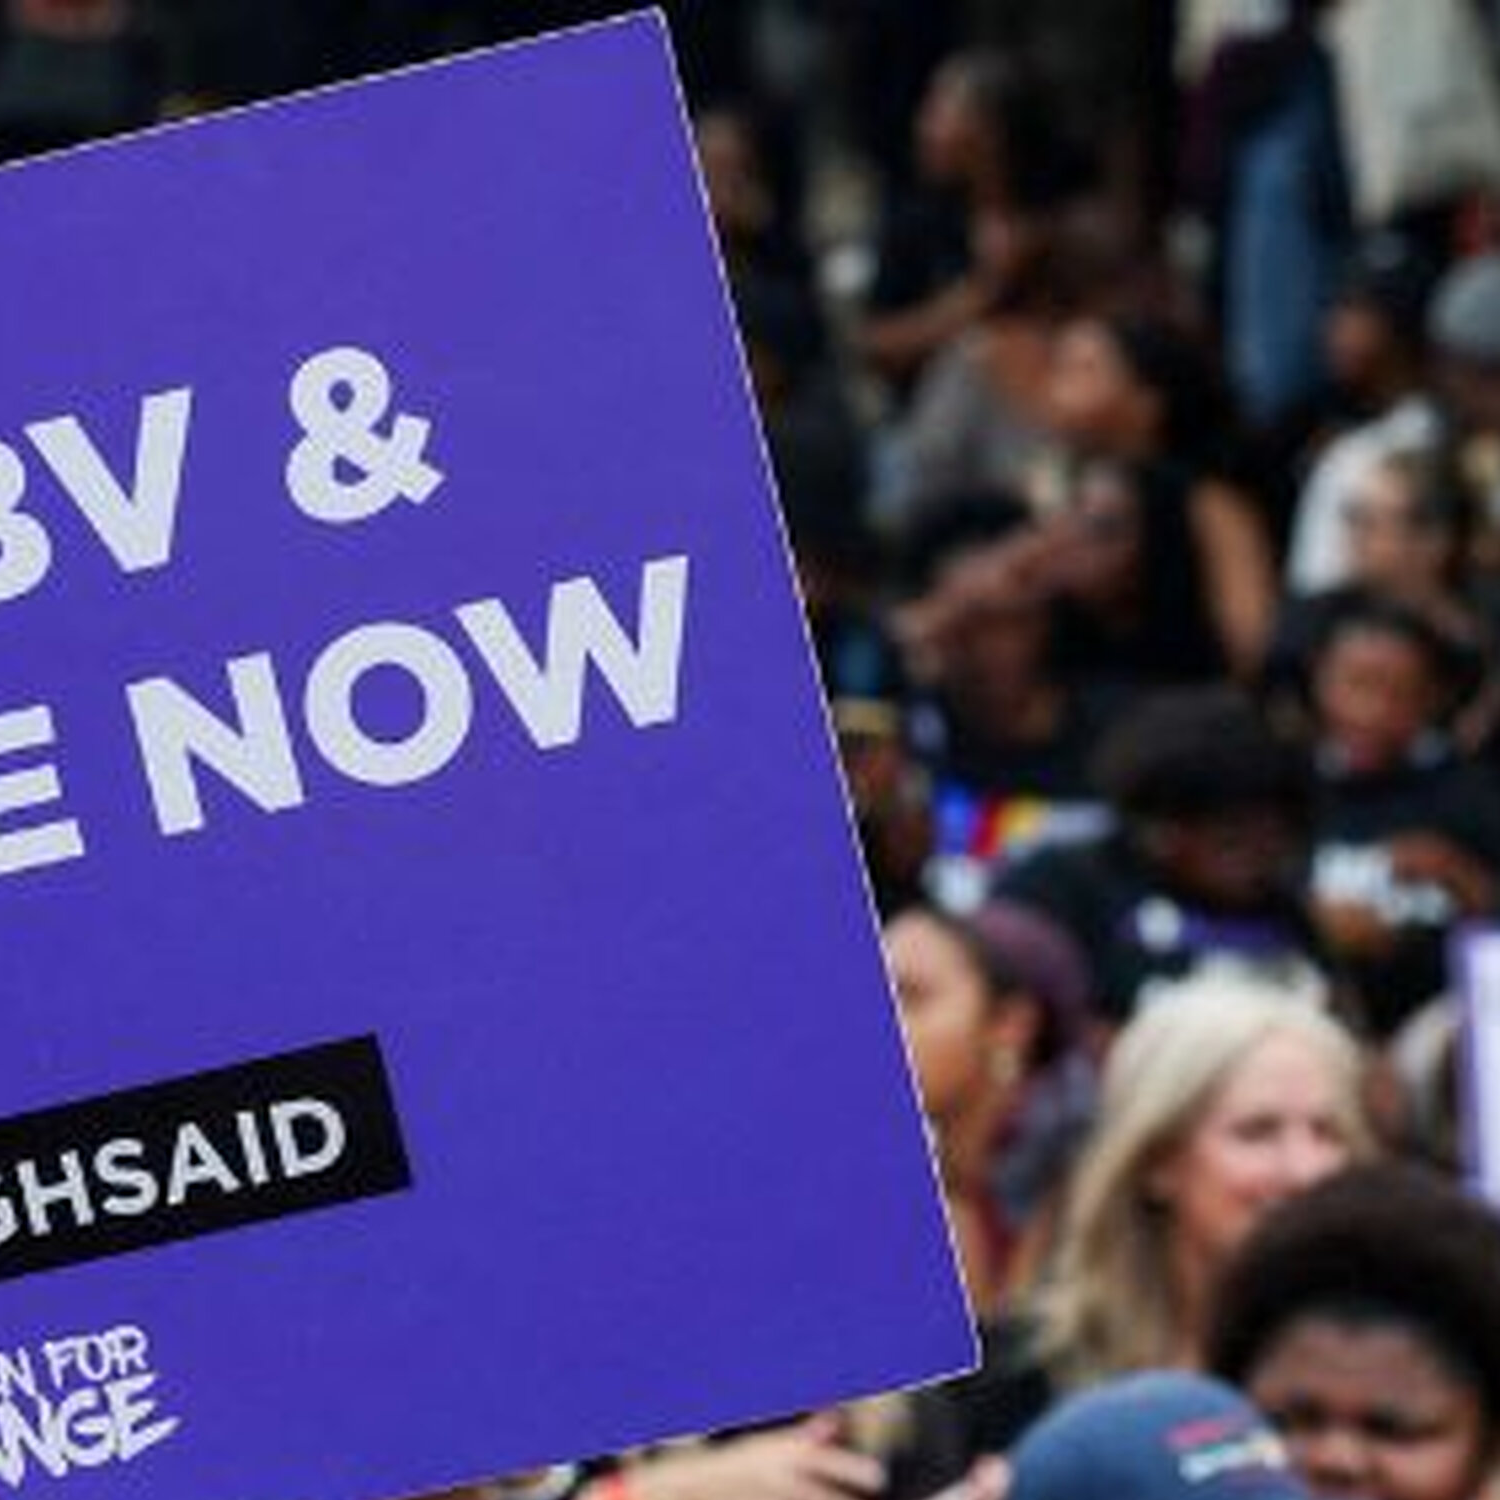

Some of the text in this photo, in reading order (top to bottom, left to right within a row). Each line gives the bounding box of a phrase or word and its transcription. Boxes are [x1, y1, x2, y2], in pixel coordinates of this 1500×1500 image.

[285, 346, 444, 523] &
[125, 555, 689, 836] NOW
[43, 1325, 149, 1388] FOR
